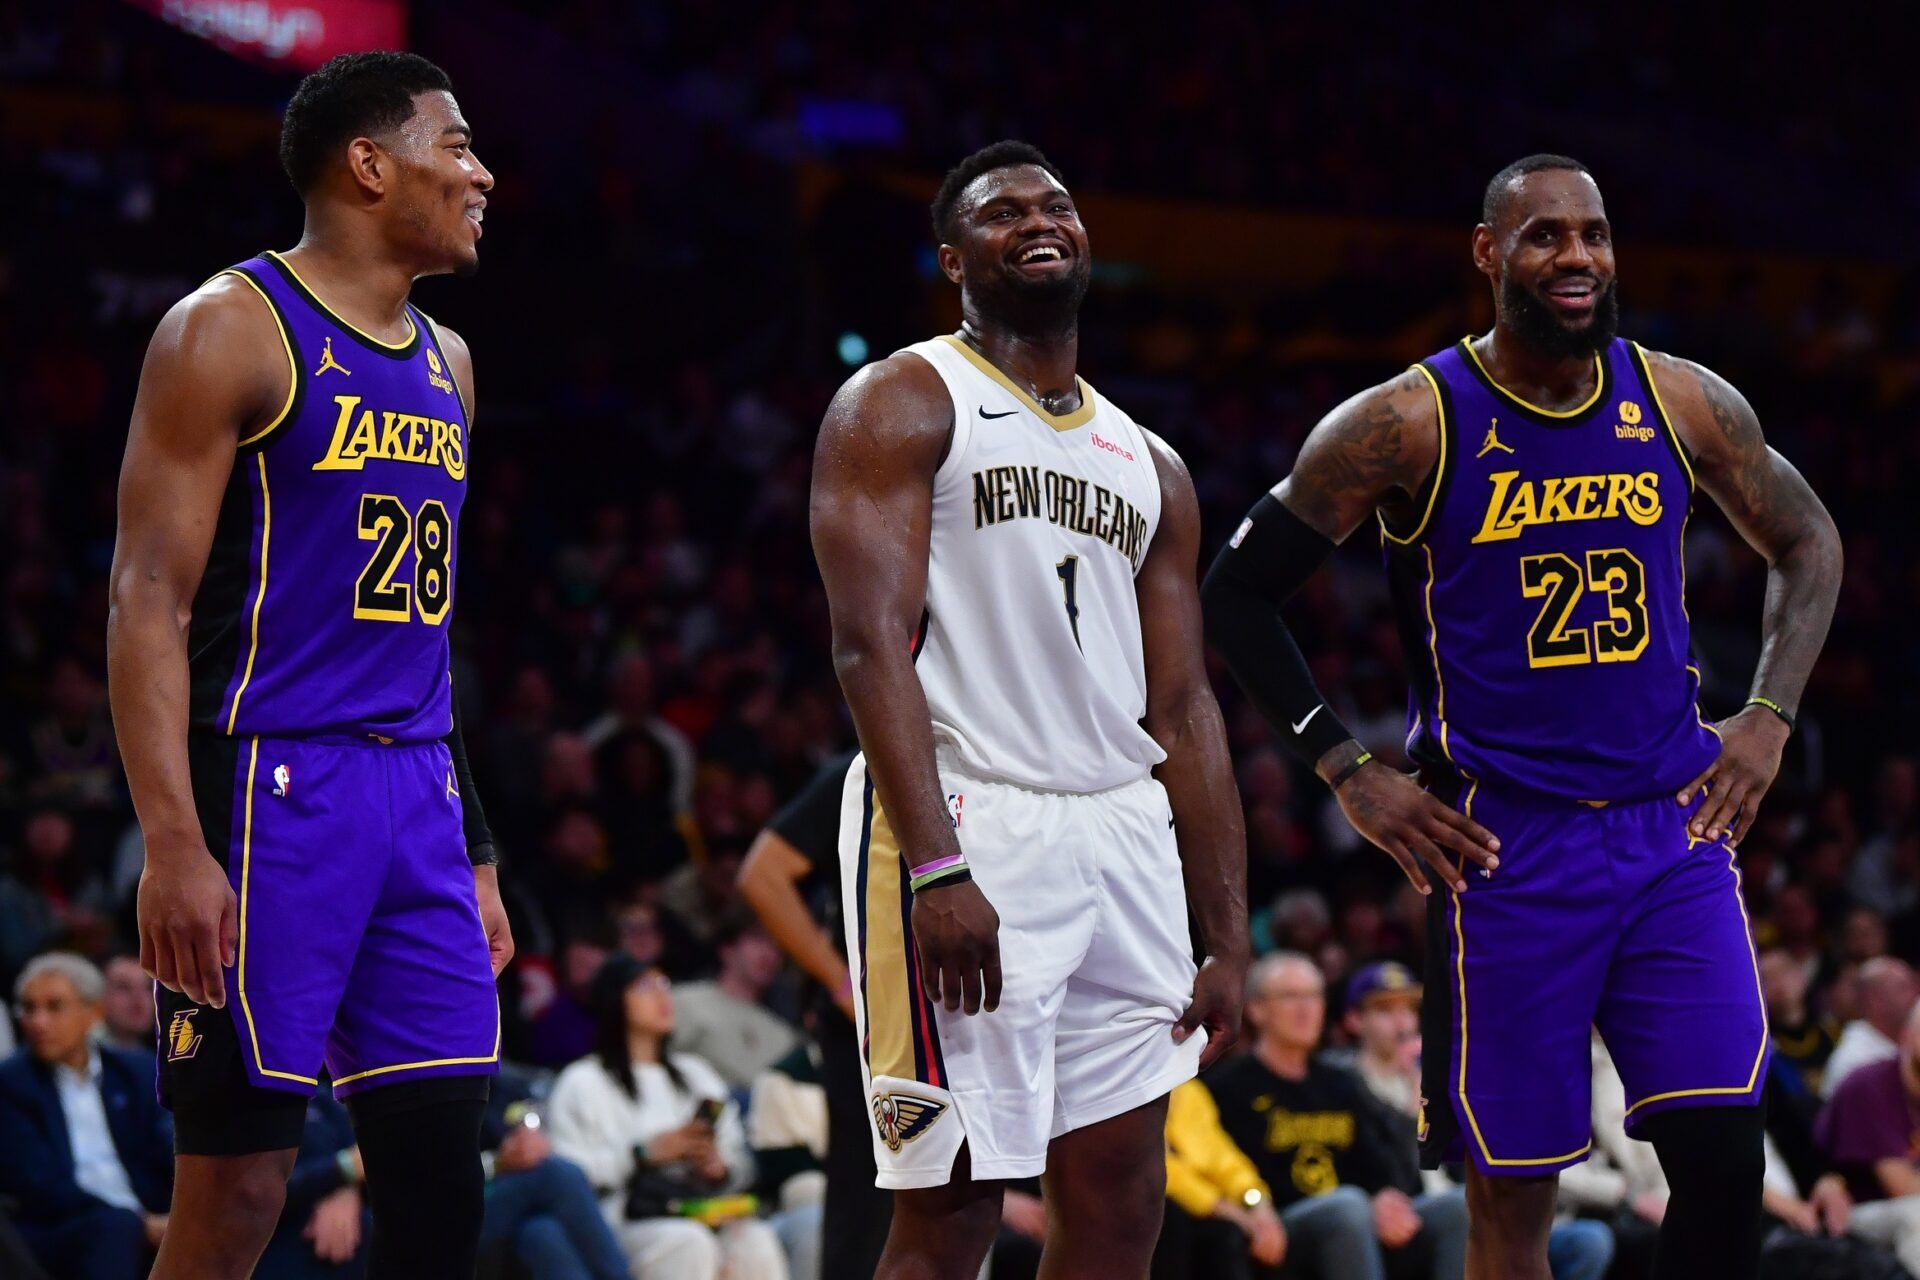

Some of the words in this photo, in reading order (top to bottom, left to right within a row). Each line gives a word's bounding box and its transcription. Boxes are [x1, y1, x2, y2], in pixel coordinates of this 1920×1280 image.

[311, 394, 466, 482] LAKERS
[1090, 431, 1135, 462] ibotta
[1614, 424, 1656, 443] bibigo
[971, 465, 1042, 531] NEW
[1043, 469, 1148, 575] ORLEANS
[1470, 470, 1664, 544] LAKERS
[353, 493, 451, 626] 28
[1055, 554, 1087, 662] 1
[1519, 547, 1650, 669] 23
